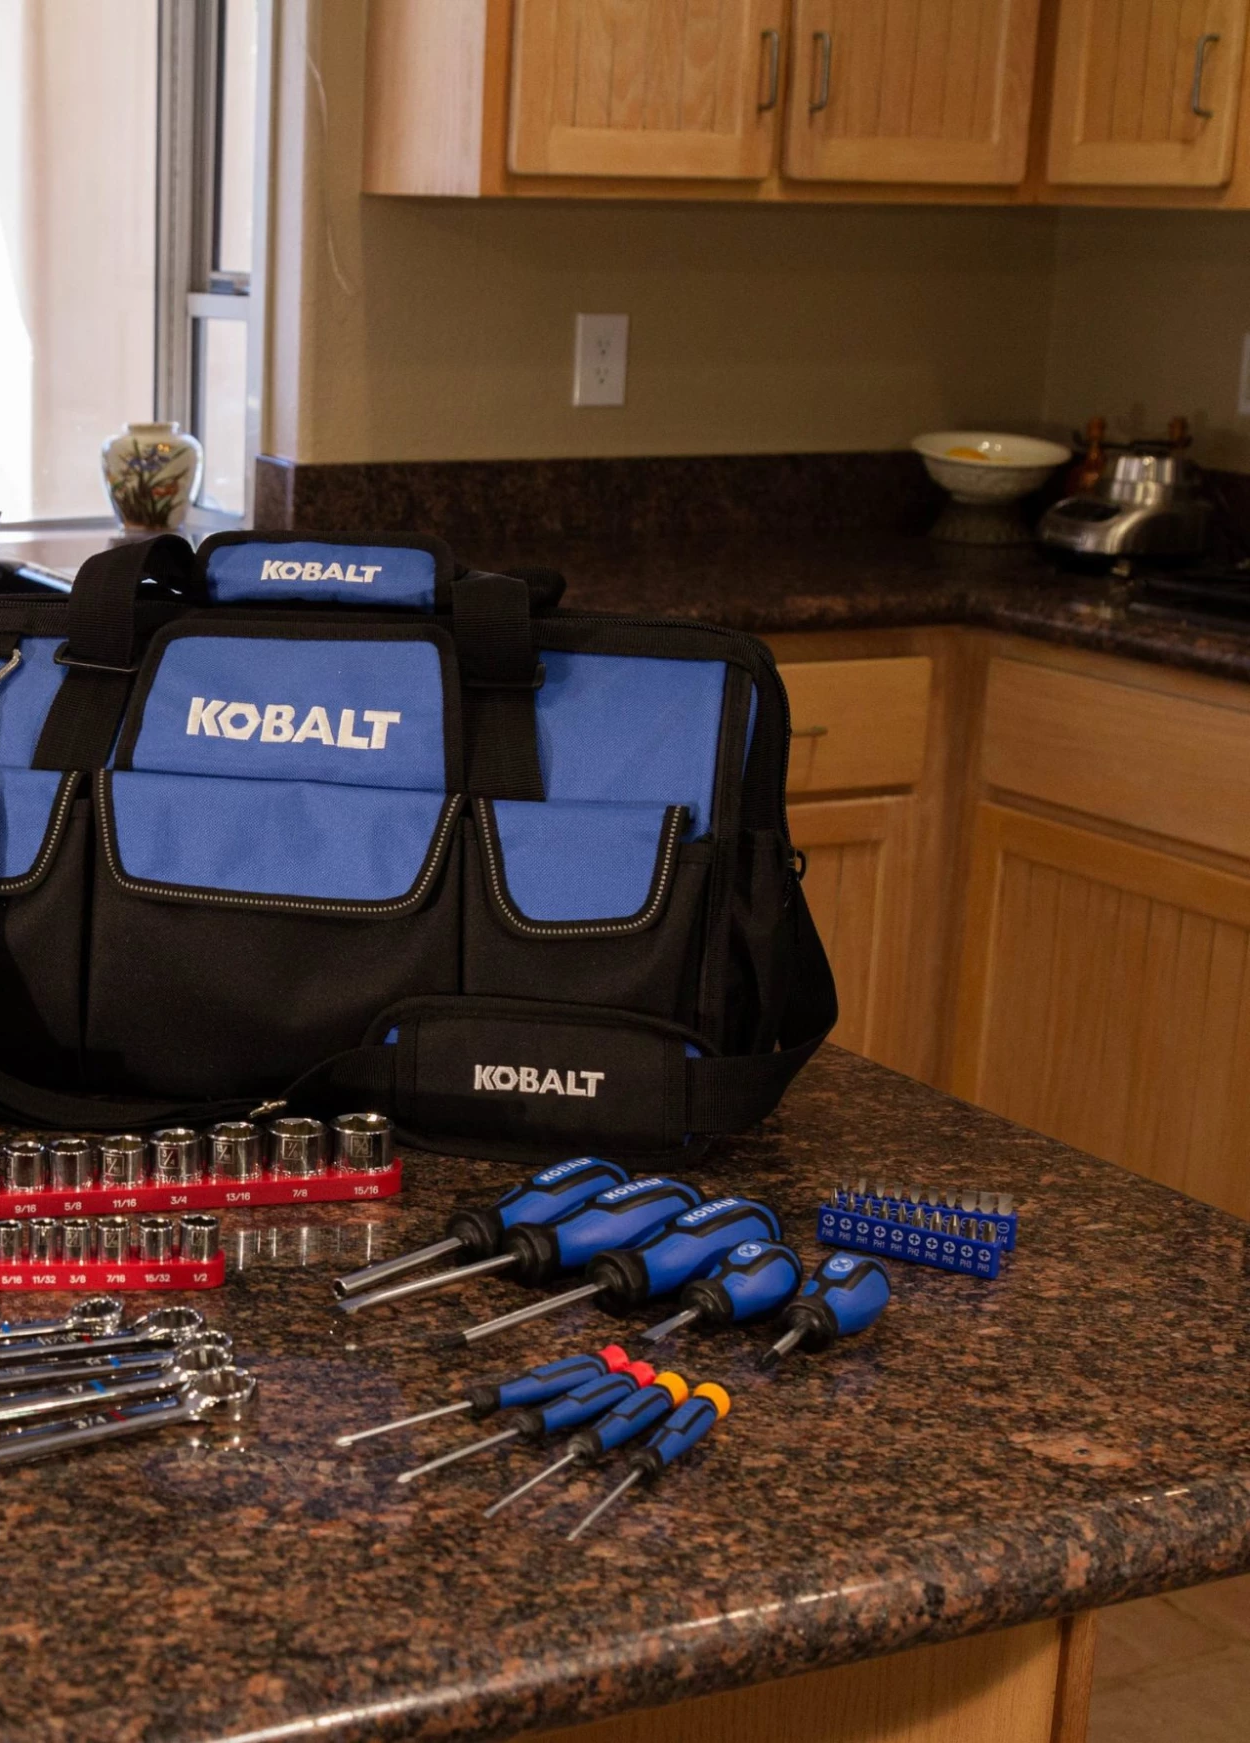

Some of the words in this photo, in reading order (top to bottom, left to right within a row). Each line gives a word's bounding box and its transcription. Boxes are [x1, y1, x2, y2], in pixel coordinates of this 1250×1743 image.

[260, 560, 382, 583] KOBALT
[186, 697, 401, 749] KOBALT
[474, 1064, 605, 1097] KOBALT
[539, 1157, 592, 1182] KOBALT
[14, 1204, 37, 1214] 9/16
[64, 1201, 82, 1211] 5/8
[112, 1198, 137, 1208] 11/16
[170, 1195, 187, 1205] 3/4
[225, 1192, 250, 1201] 13/16
[292, 1188, 308, 1198] 7/8
[354, 1185, 379, 1195] 15/16
[604, 1177, 664, 1200] KOBALT
[683, 1198, 739, 1223] KOBALT
[856, 1234, 868, 1245] PH1
[873, 1238, 886, 1249] PH1
[907, 1246, 920, 1257] PH2
[925, 1250, 937, 1261] PH2
[942, 1254, 955, 1265] PH2
[1, 1274, 23, 1284] 5/16
[32, 1274, 57, 1284] 11/32
[69, 1274, 87, 1284] 3/8
[106, 1274, 126, 1284] 7/16
[144, 1273, 171, 1283] 15/32
[193, 1273, 208, 1283] 1/2
